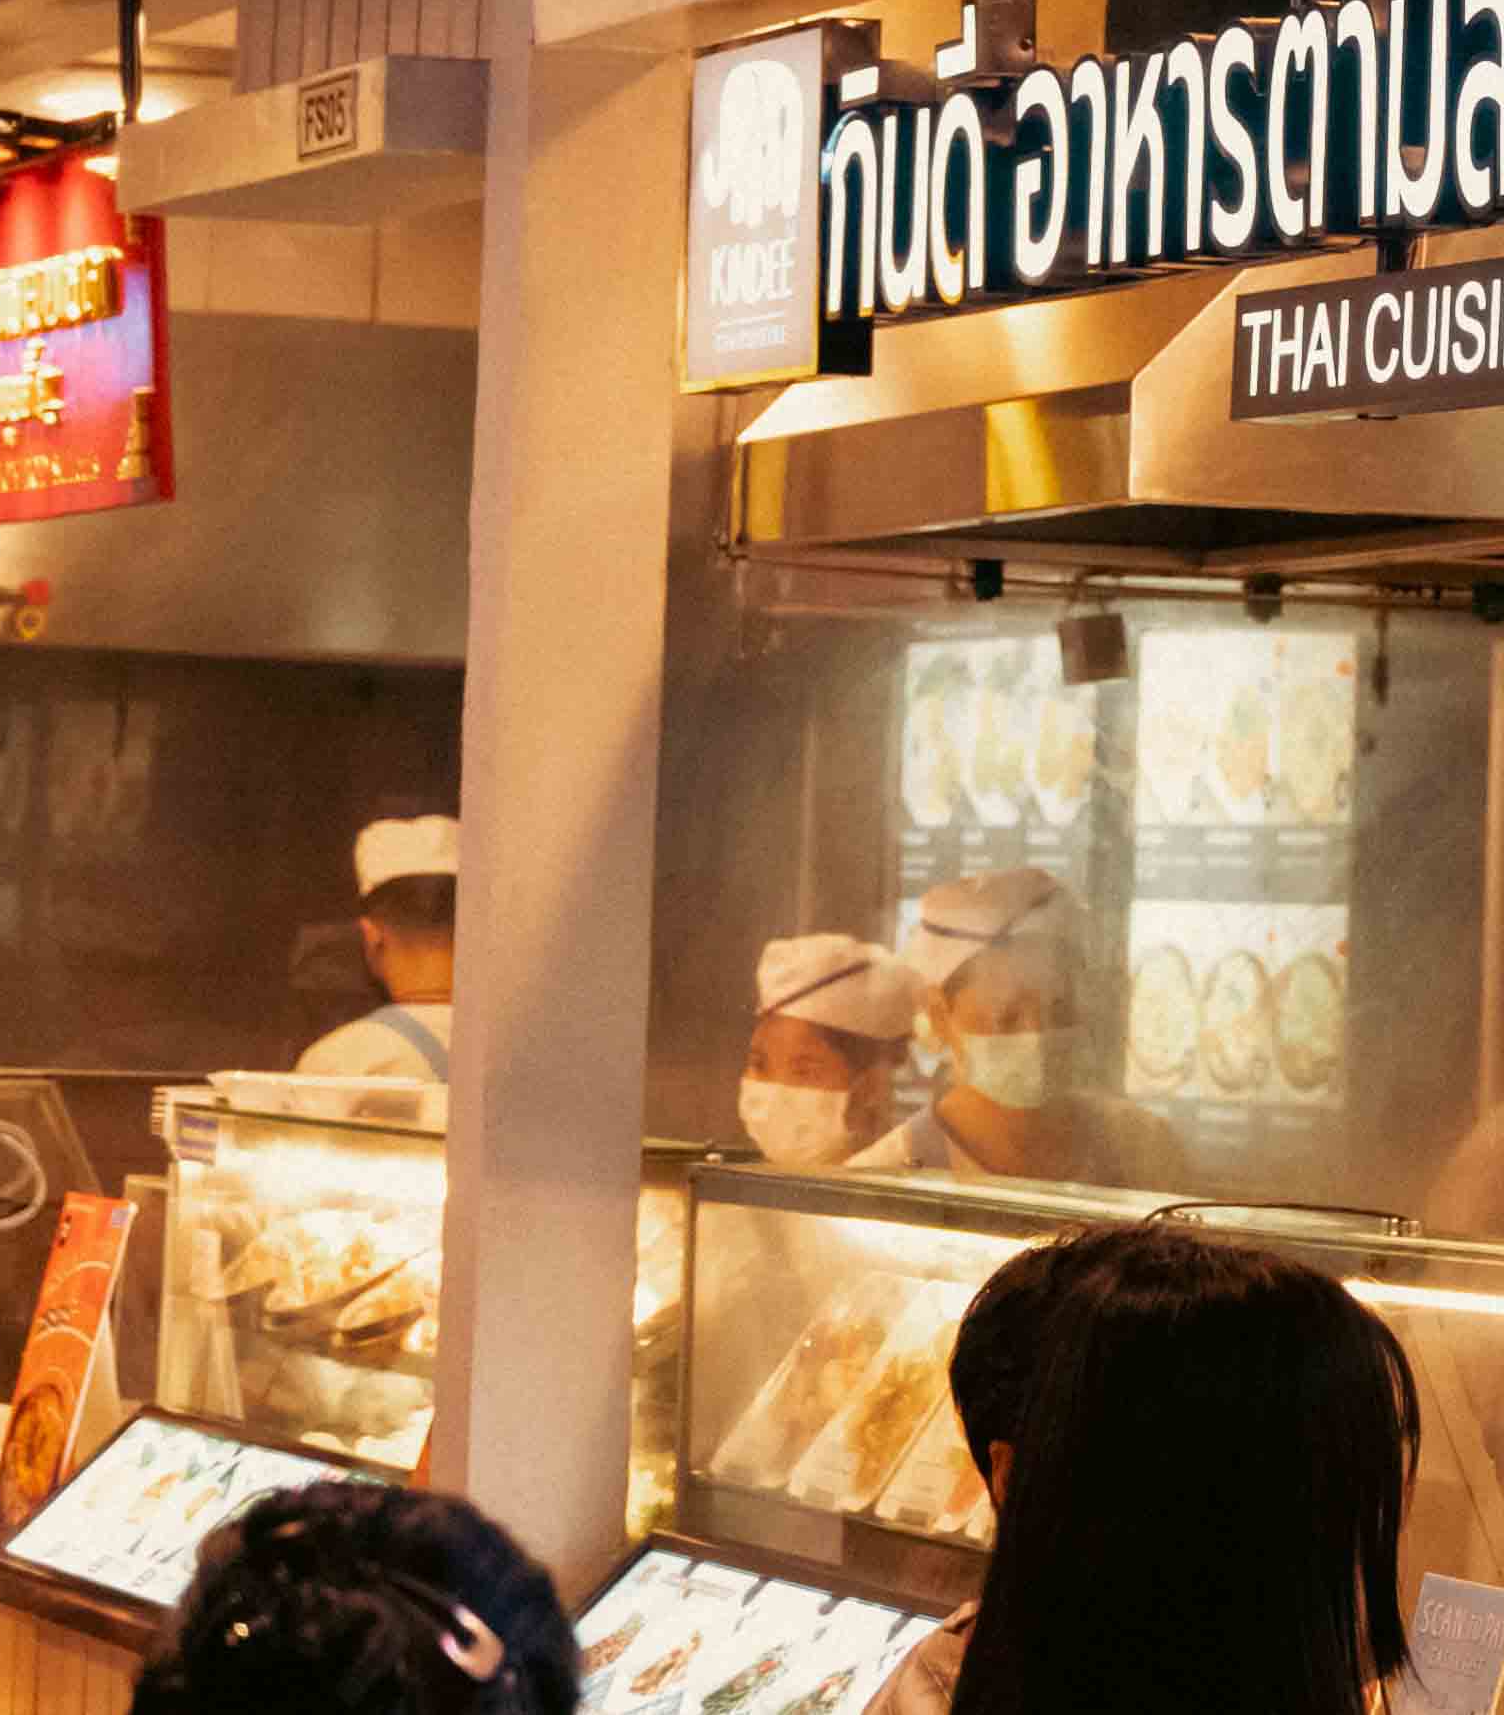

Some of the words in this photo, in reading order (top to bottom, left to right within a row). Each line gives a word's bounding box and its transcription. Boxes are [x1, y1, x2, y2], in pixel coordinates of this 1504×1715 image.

[305, 89, 346, 143] FS05
[826, 4, 986, 320] กินดี
[1242, 298, 1350, 397] THAI
